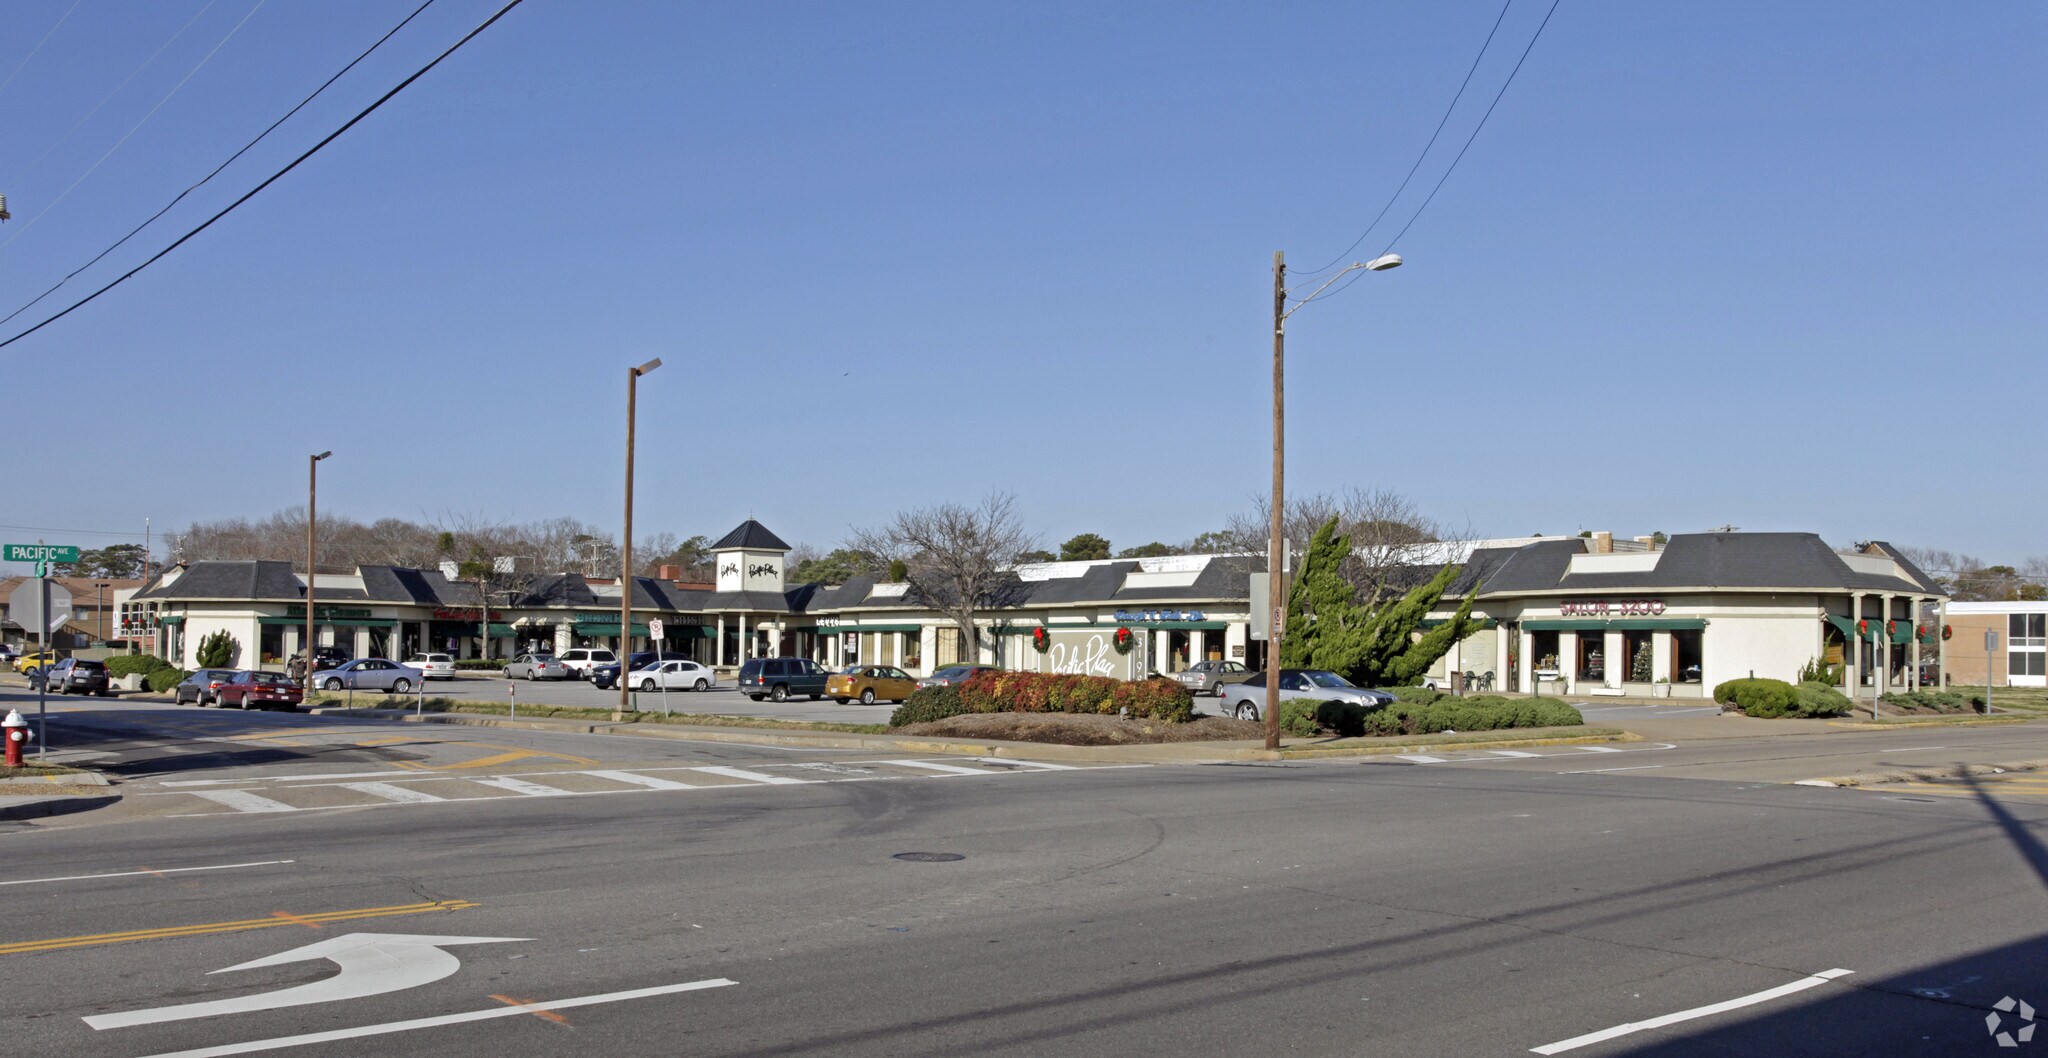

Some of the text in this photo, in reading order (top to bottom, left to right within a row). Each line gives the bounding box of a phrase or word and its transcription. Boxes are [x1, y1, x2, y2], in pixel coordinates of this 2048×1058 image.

[12, 546, 69, 560] PACIFIC AVE
[286, 605, 326, 617] Atlatic
[1560, 599, 1666, 616] SALON 3200
[1085, 634, 1115, 677] Place
